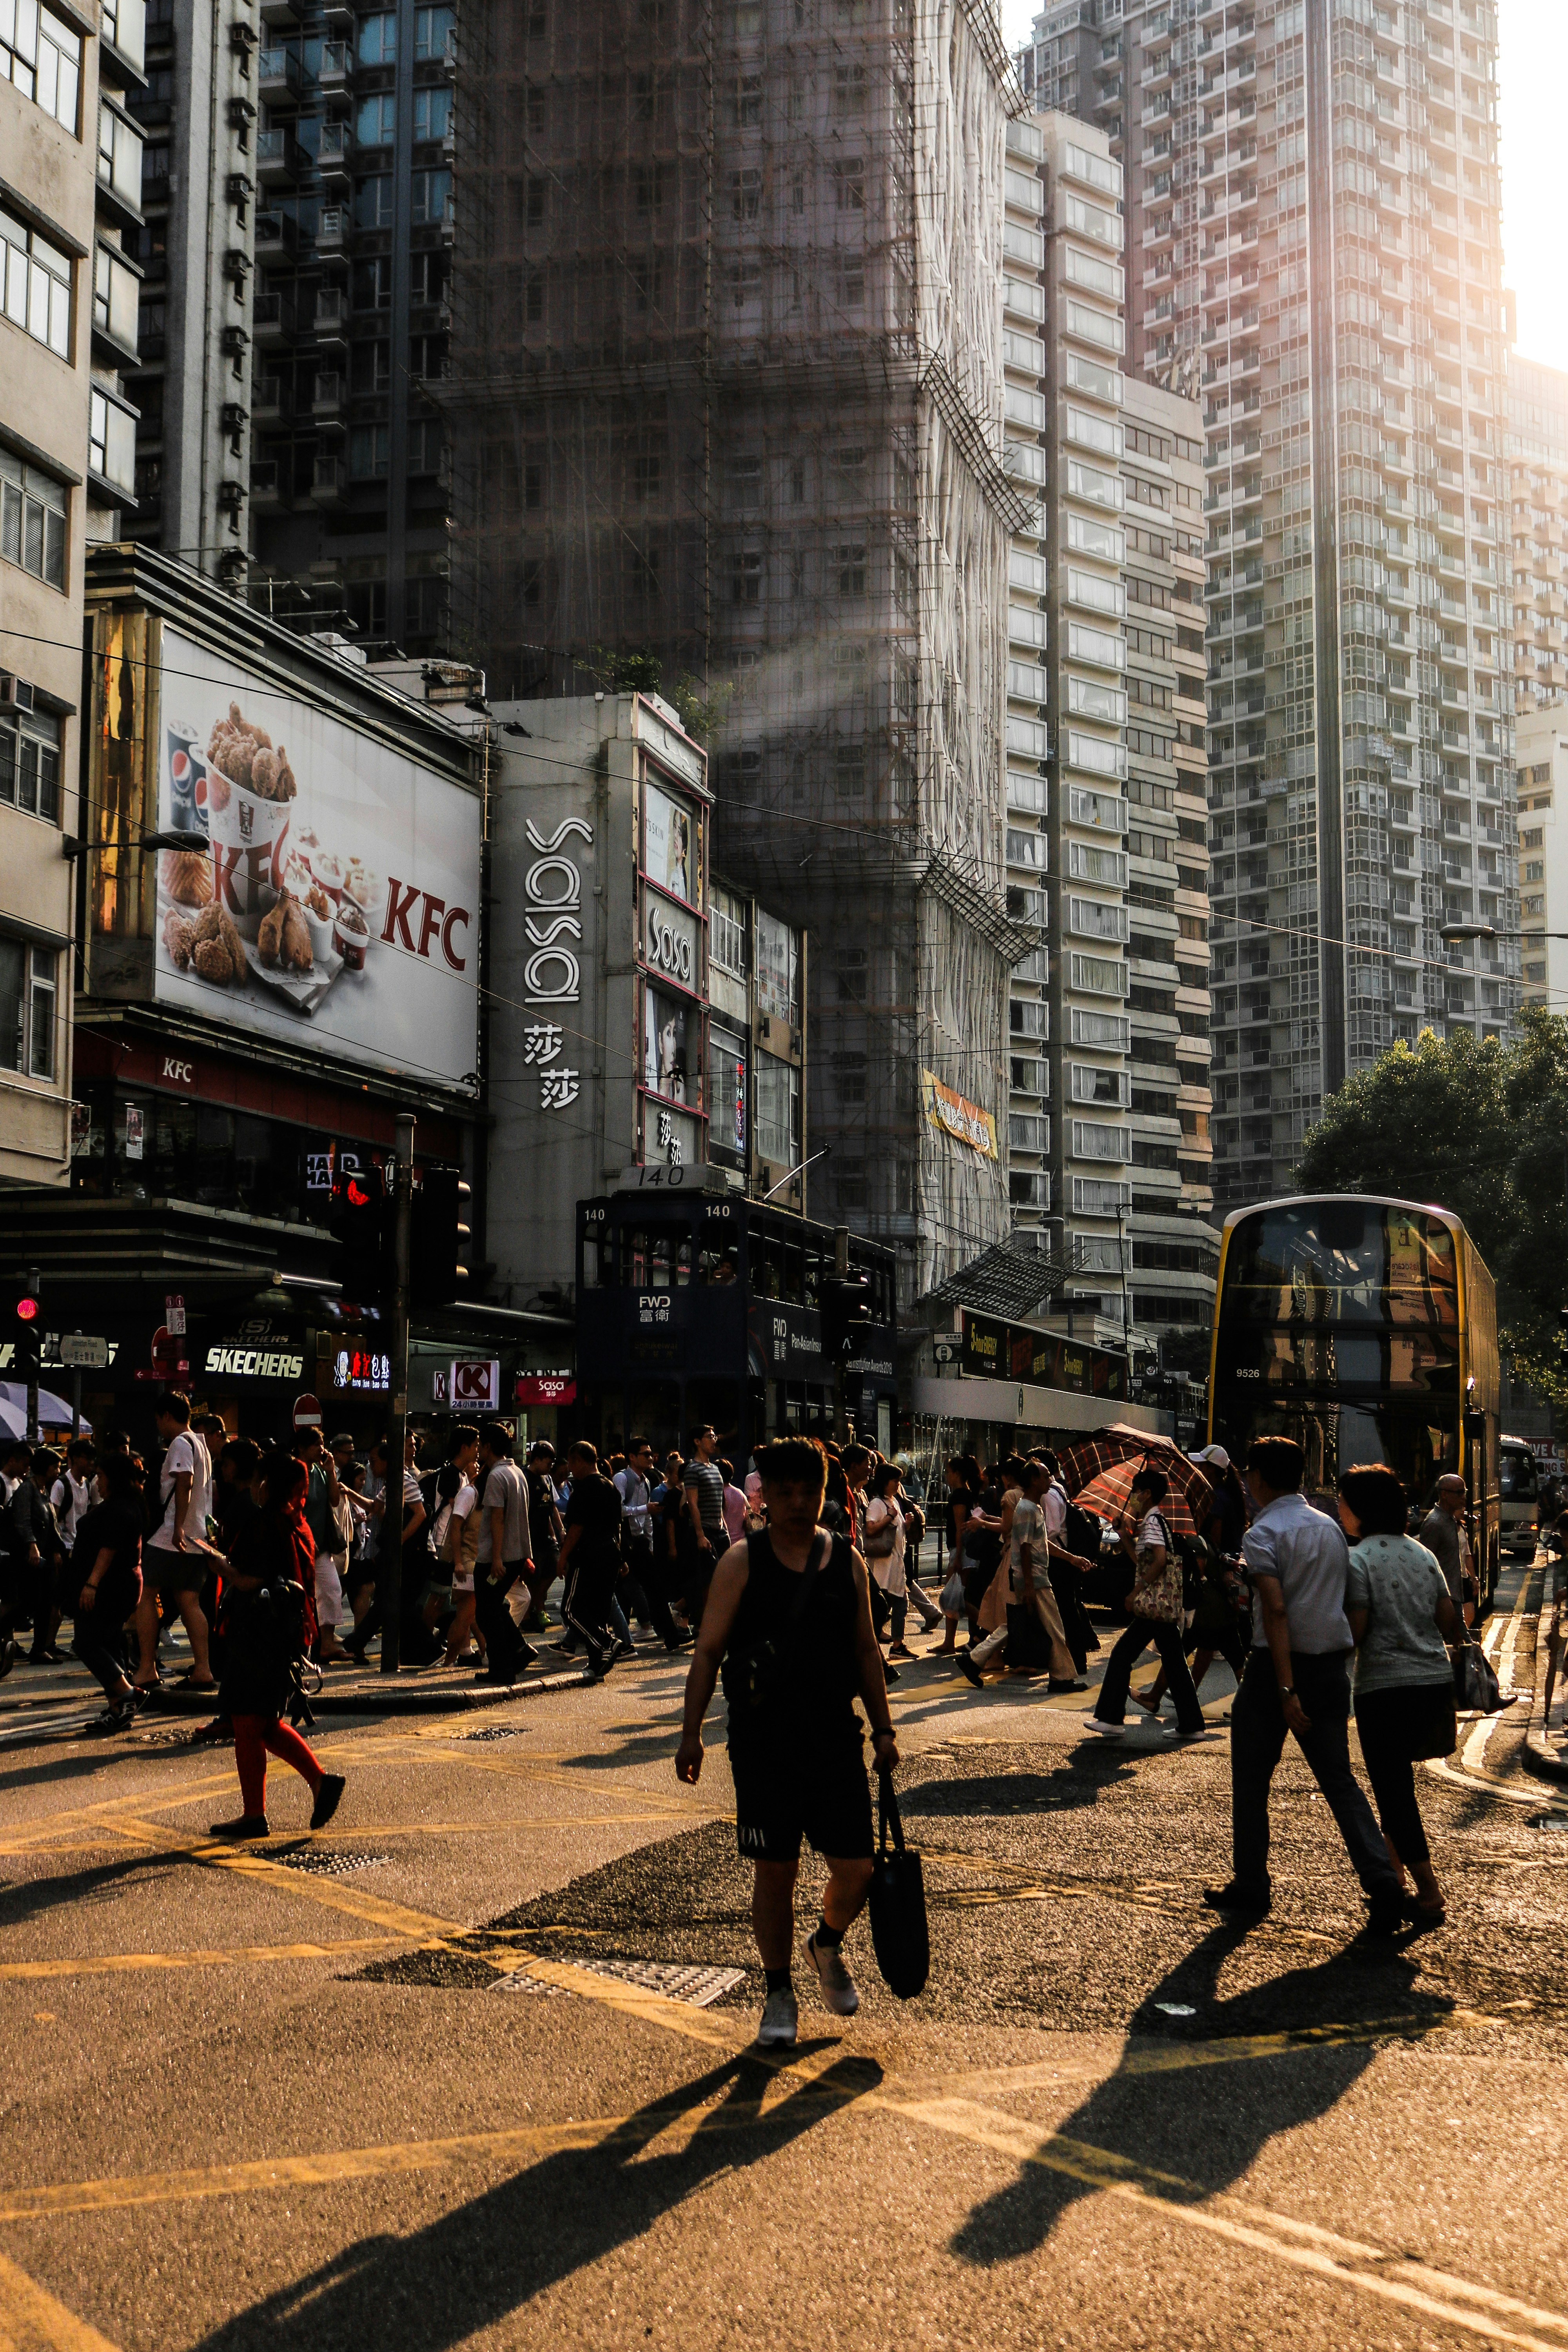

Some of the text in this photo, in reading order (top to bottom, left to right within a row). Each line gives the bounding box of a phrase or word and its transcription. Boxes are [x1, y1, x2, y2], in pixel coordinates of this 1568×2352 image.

[381, 876, 469, 971] KFC
[162, 1057, 192, 1083] KFC
[524, 1024, 580, 1109] 莎莎
[639, 1166, 684, 1187] 140
[585, 1209, 605, 1221] 140
[706, 1205, 730, 1217] 140
[639, 1296, 670, 1308] FWD
[640, 1309, 670, 1322] 富衛
[774, 1317, 787, 1338] FWD
[222, 1335, 289, 1343] SKECHERS
[205, 1347, 303, 1378] SKECHERS
[1236, 1368, 1259, 1378] 9526
